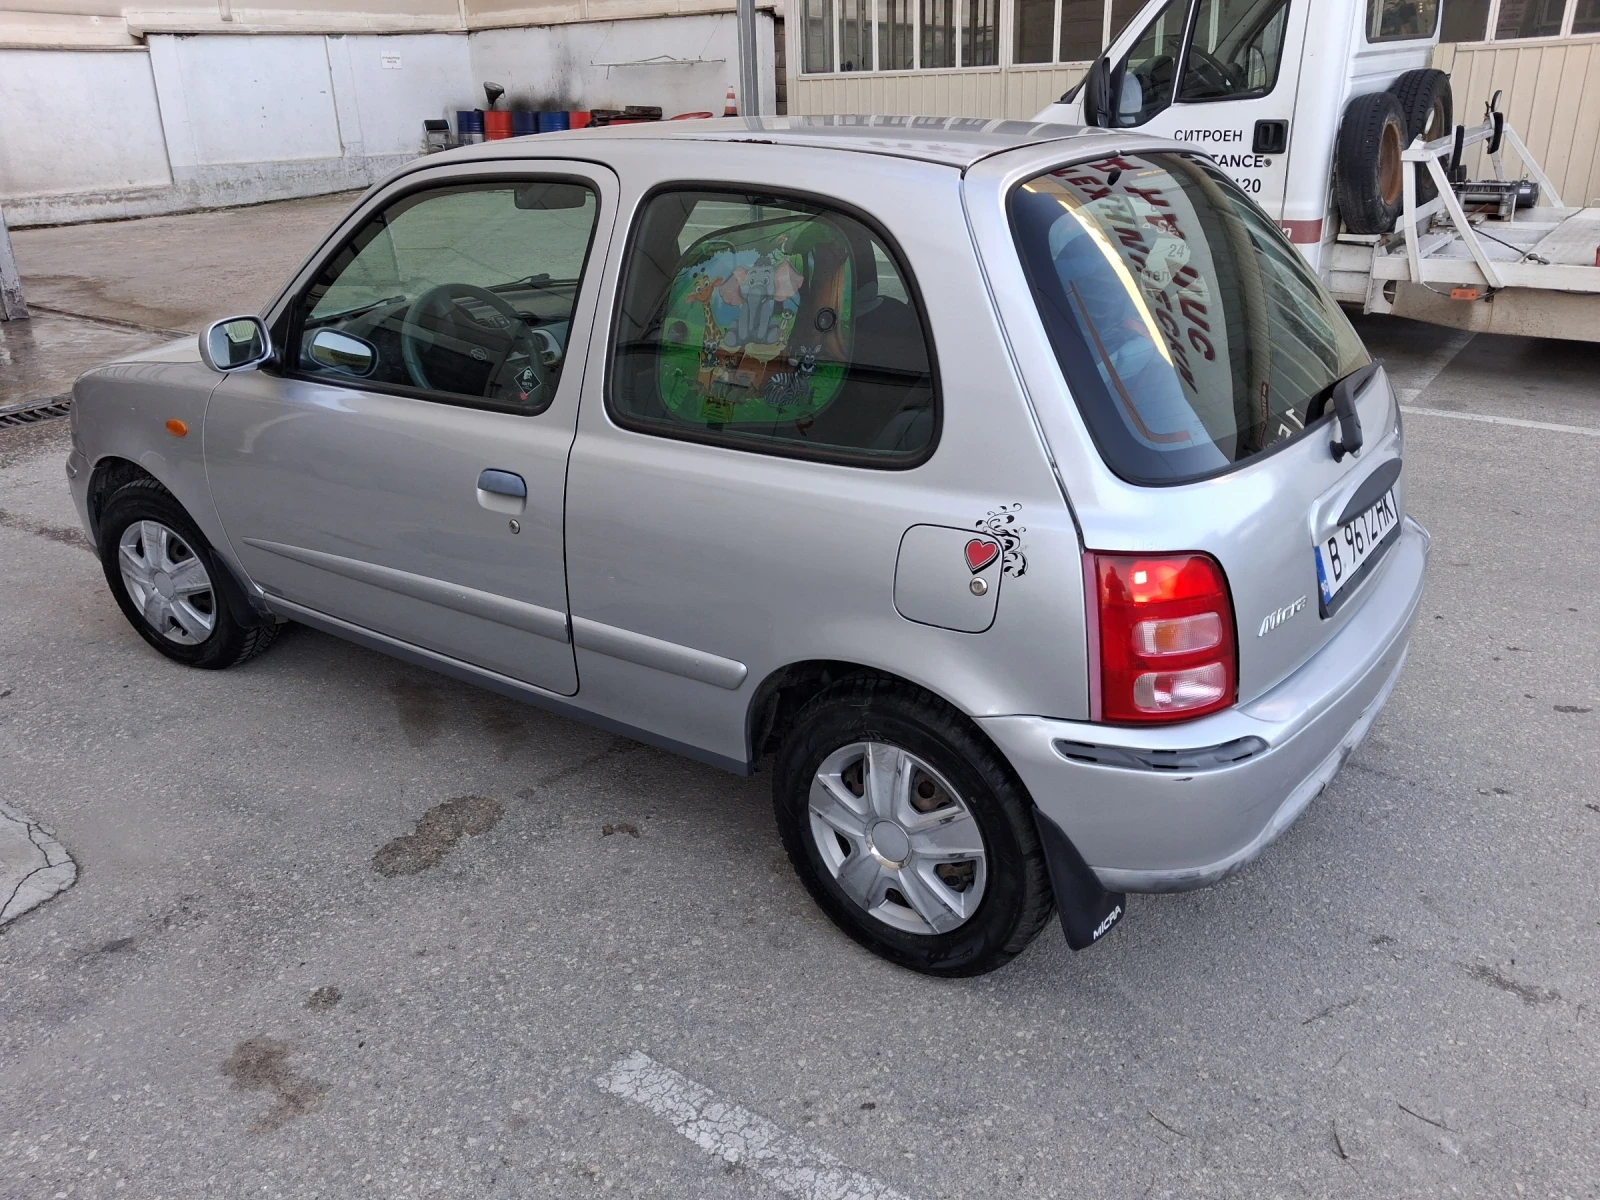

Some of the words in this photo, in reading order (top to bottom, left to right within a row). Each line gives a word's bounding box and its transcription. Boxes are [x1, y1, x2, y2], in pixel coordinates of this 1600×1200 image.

[1174, 129, 1243, 142] СИТРОЕН
[1327, 537, 1342, 582] B
[1258, 595, 1307, 637] Micra
[1093, 905, 1122, 940] MICRA
